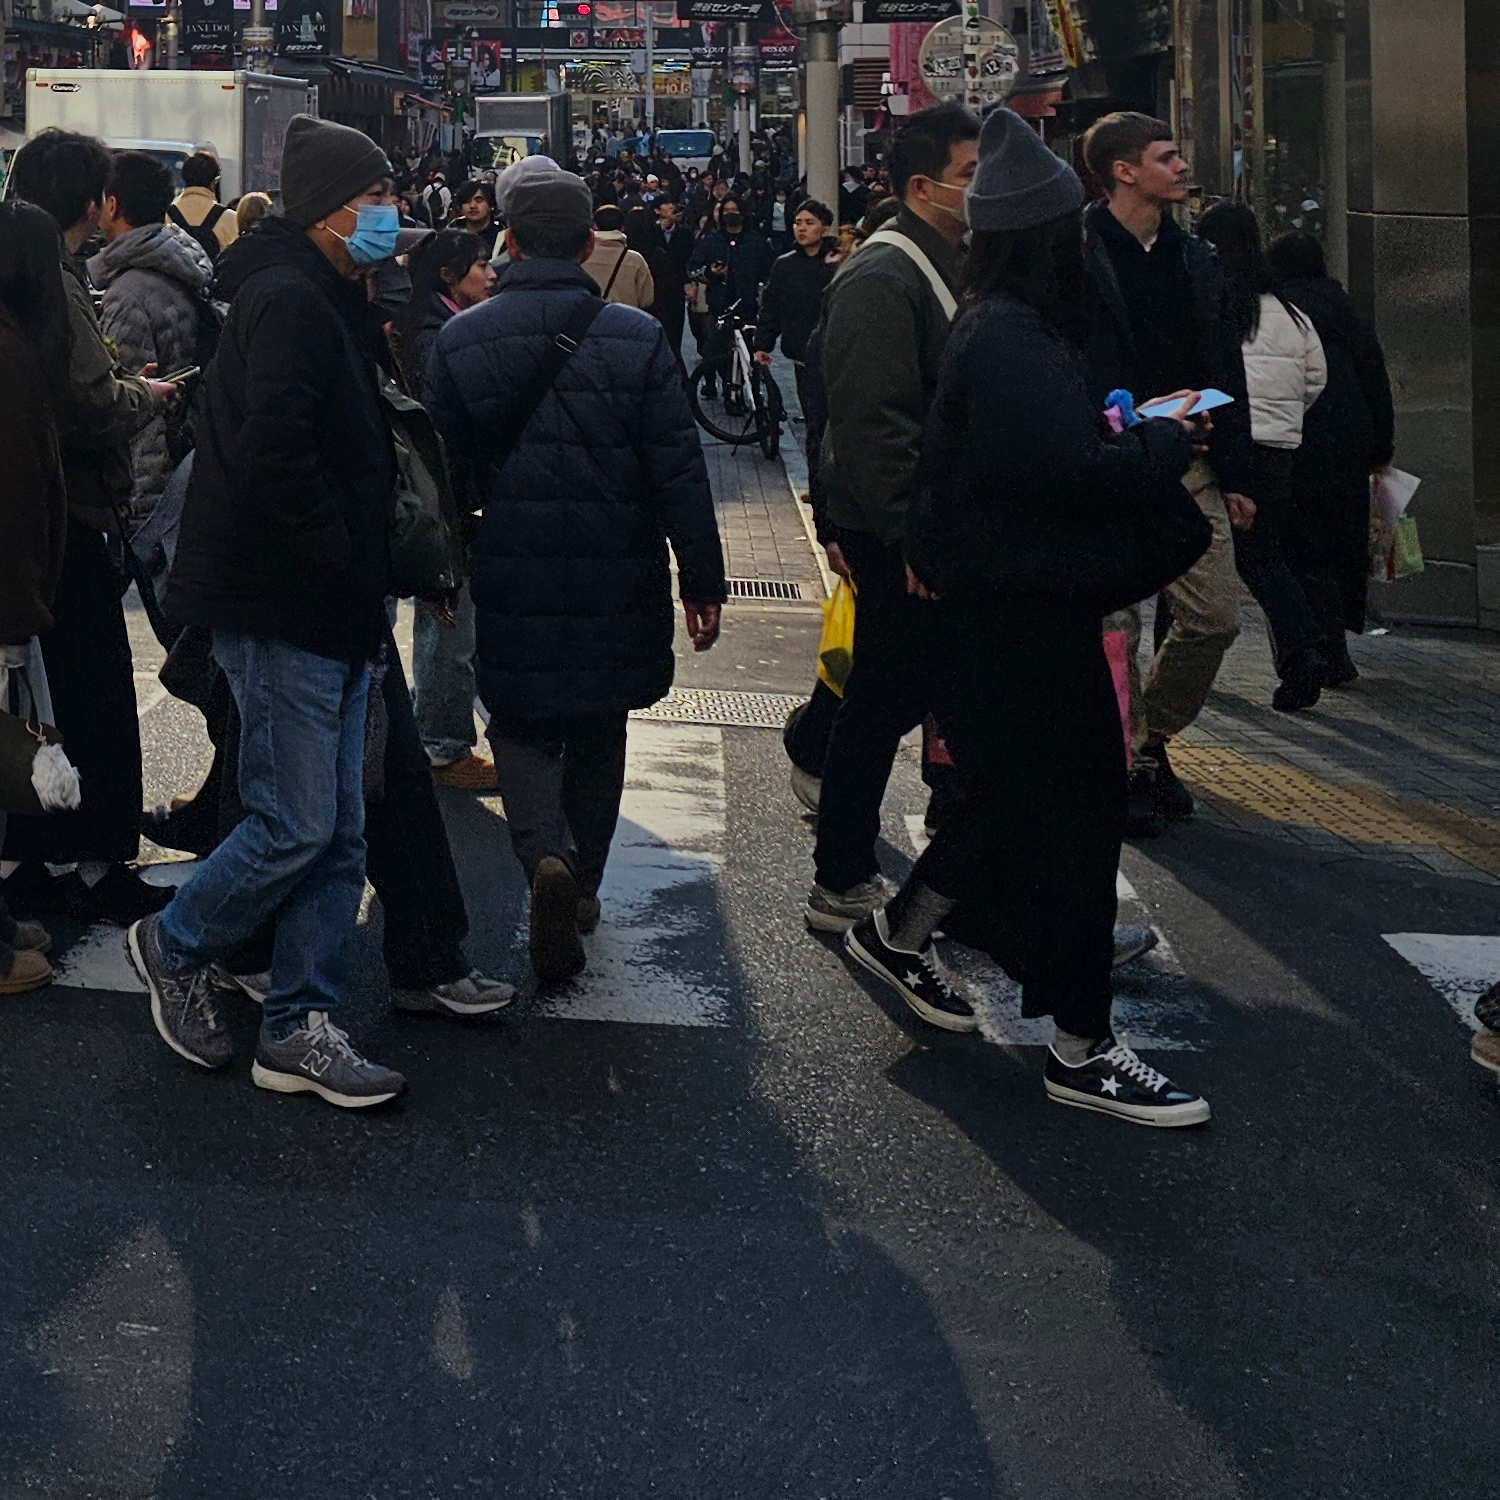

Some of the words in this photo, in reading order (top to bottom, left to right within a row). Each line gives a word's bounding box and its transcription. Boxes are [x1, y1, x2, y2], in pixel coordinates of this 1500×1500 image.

[691, 2, 762, 13] 渋谷センター街
